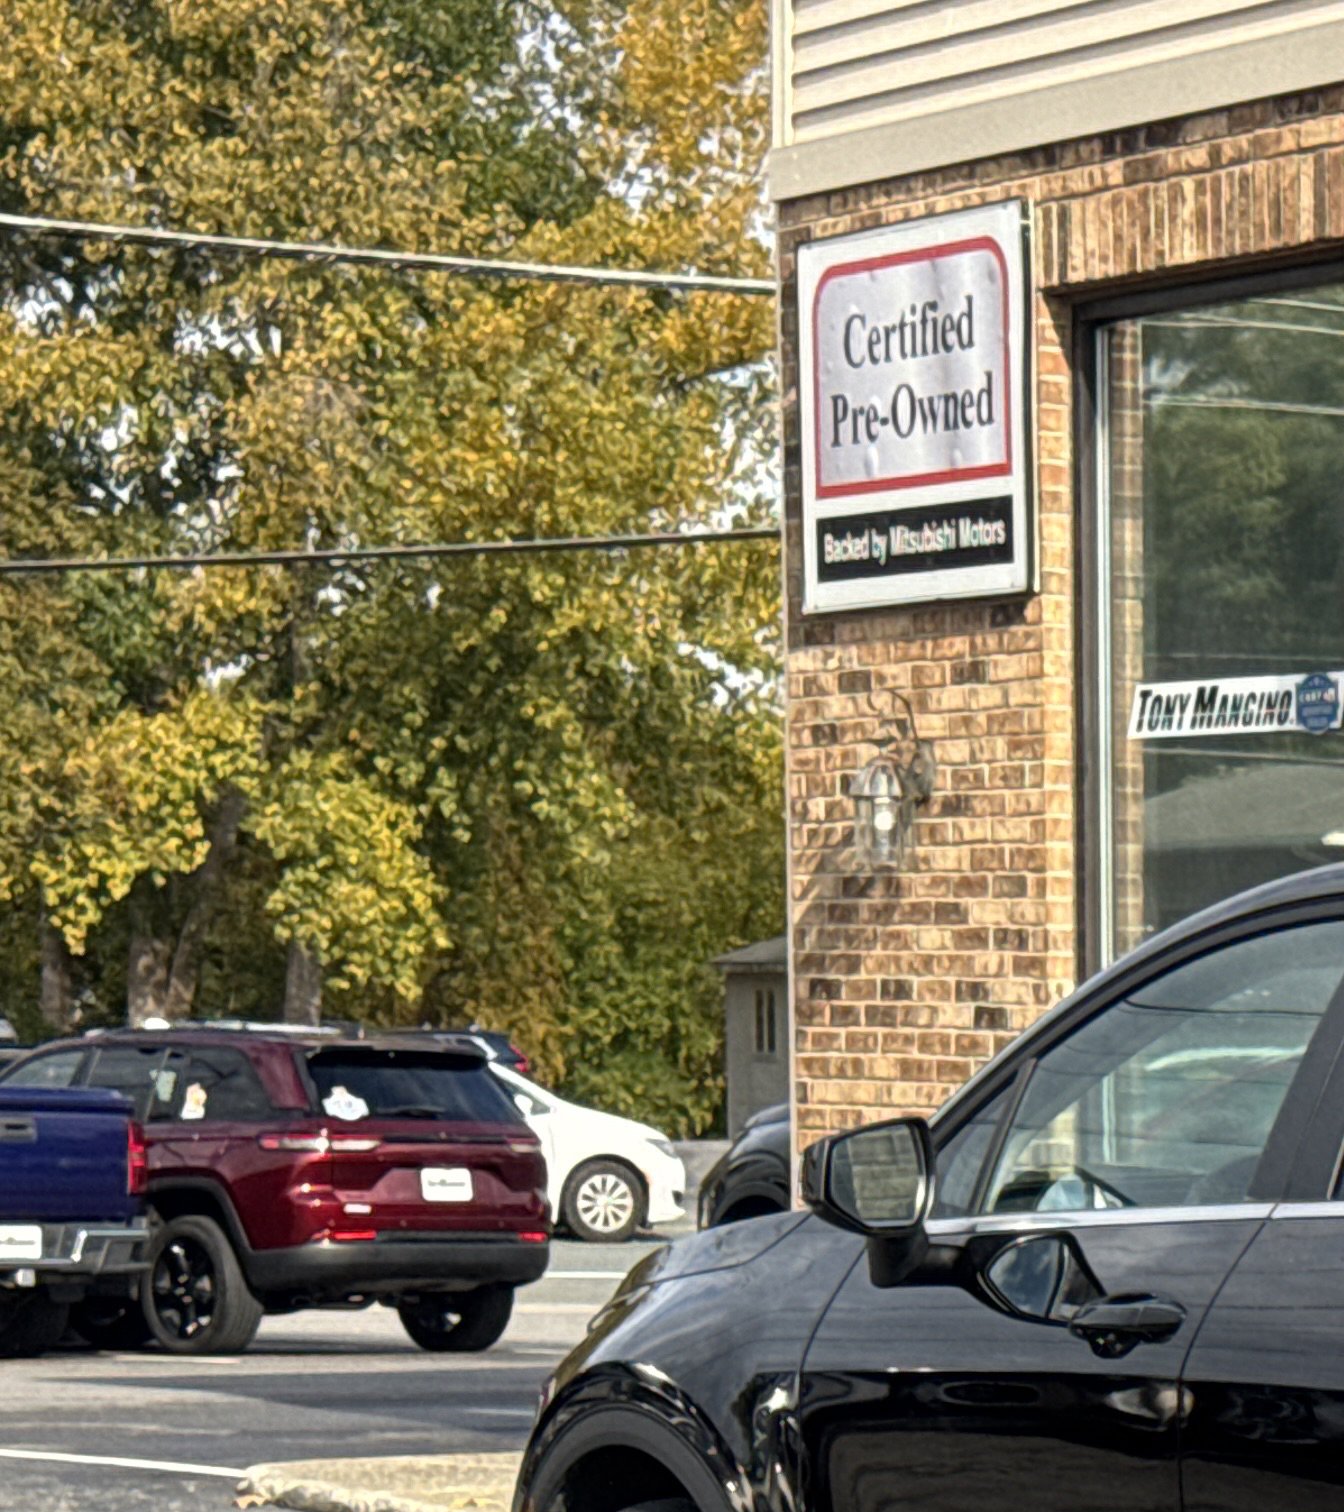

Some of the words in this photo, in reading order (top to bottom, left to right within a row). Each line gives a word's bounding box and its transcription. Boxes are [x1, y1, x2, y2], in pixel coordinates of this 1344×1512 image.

[843, 294, 975, 369] Certified
[831, 370, 995, 448] Pre-Owned
[824, 528, 870, 564] Backed
[871, 528, 888, 567] by
[889, 518, 957, 556] Mitsubishi
[958, 517, 1006, 548] Motors
[1136, 688, 1191, 733] TONY
[1190, 685, 1293, 730] MANGINO
